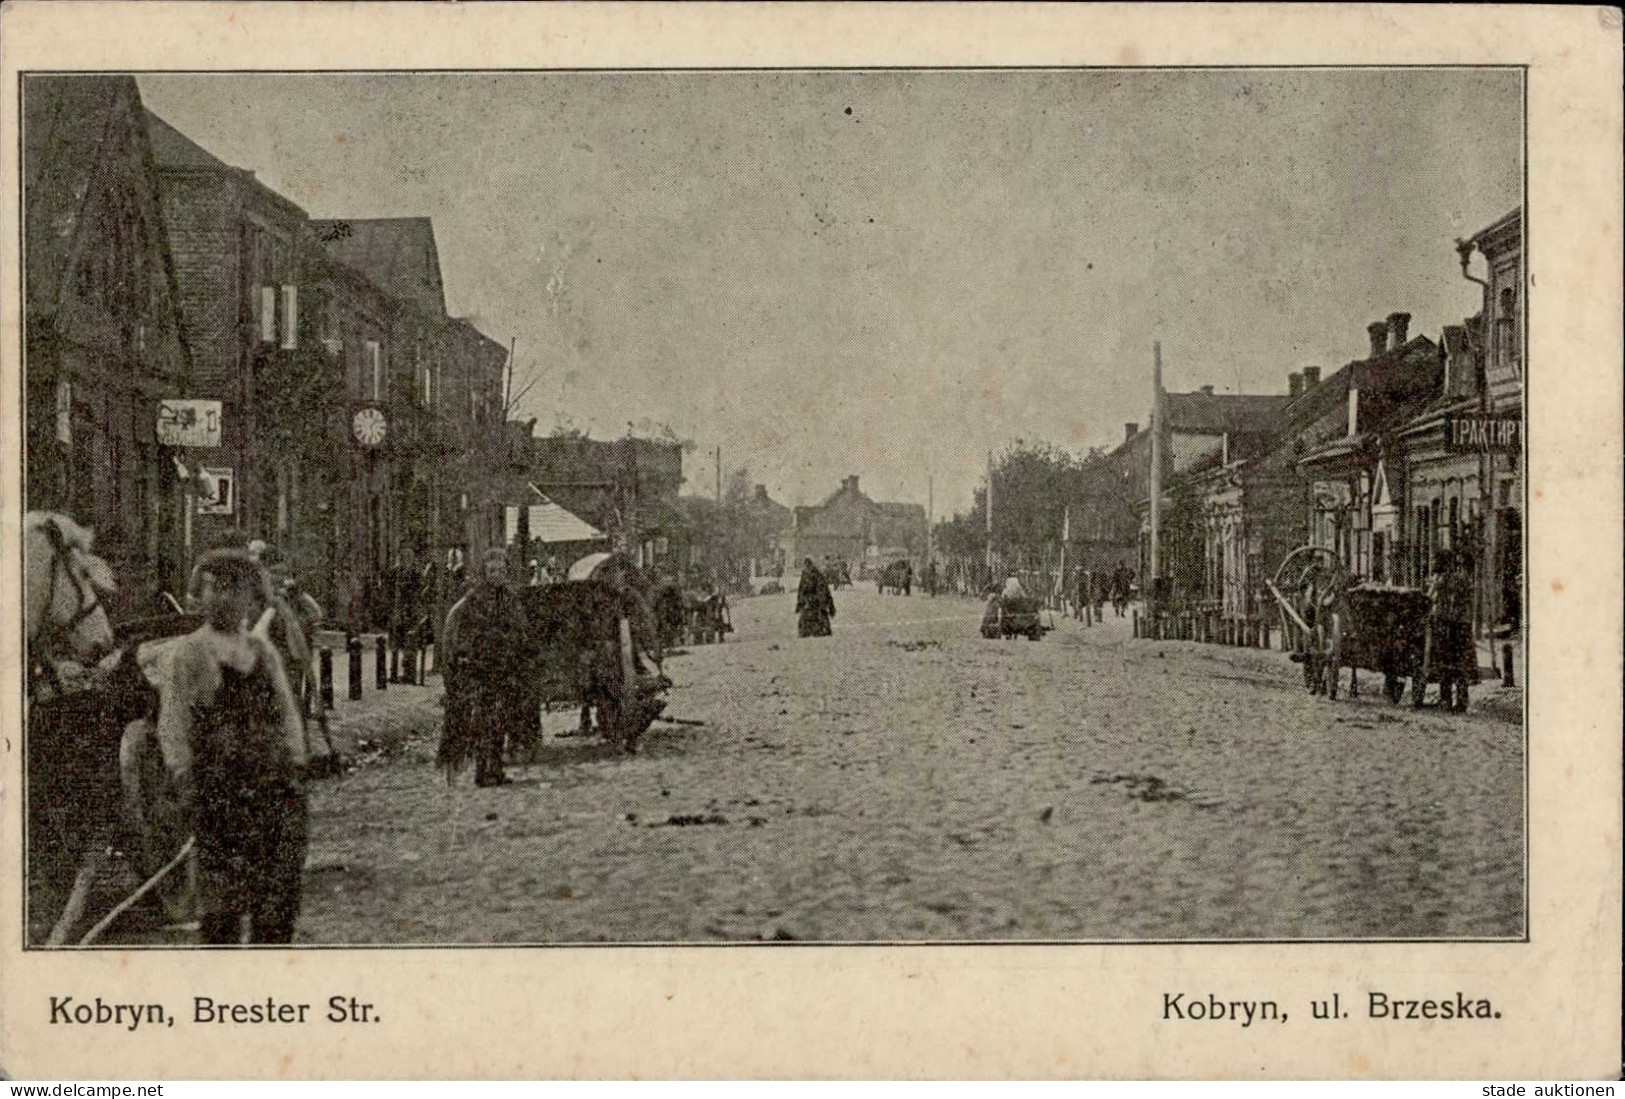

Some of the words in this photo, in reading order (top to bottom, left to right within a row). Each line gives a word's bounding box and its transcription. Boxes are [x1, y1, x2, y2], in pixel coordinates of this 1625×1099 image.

[49, 996, 174, 1031] Kobryn,
[193, 997, 310, 1024] Brester
[327, 995, 380, 1023] Str.
[1163, 993, 1288, 1027] Kobryn,
[1311, 993, 1348, 1019] ul.
[1368, 992, 1502, 1020] Brzeska.
